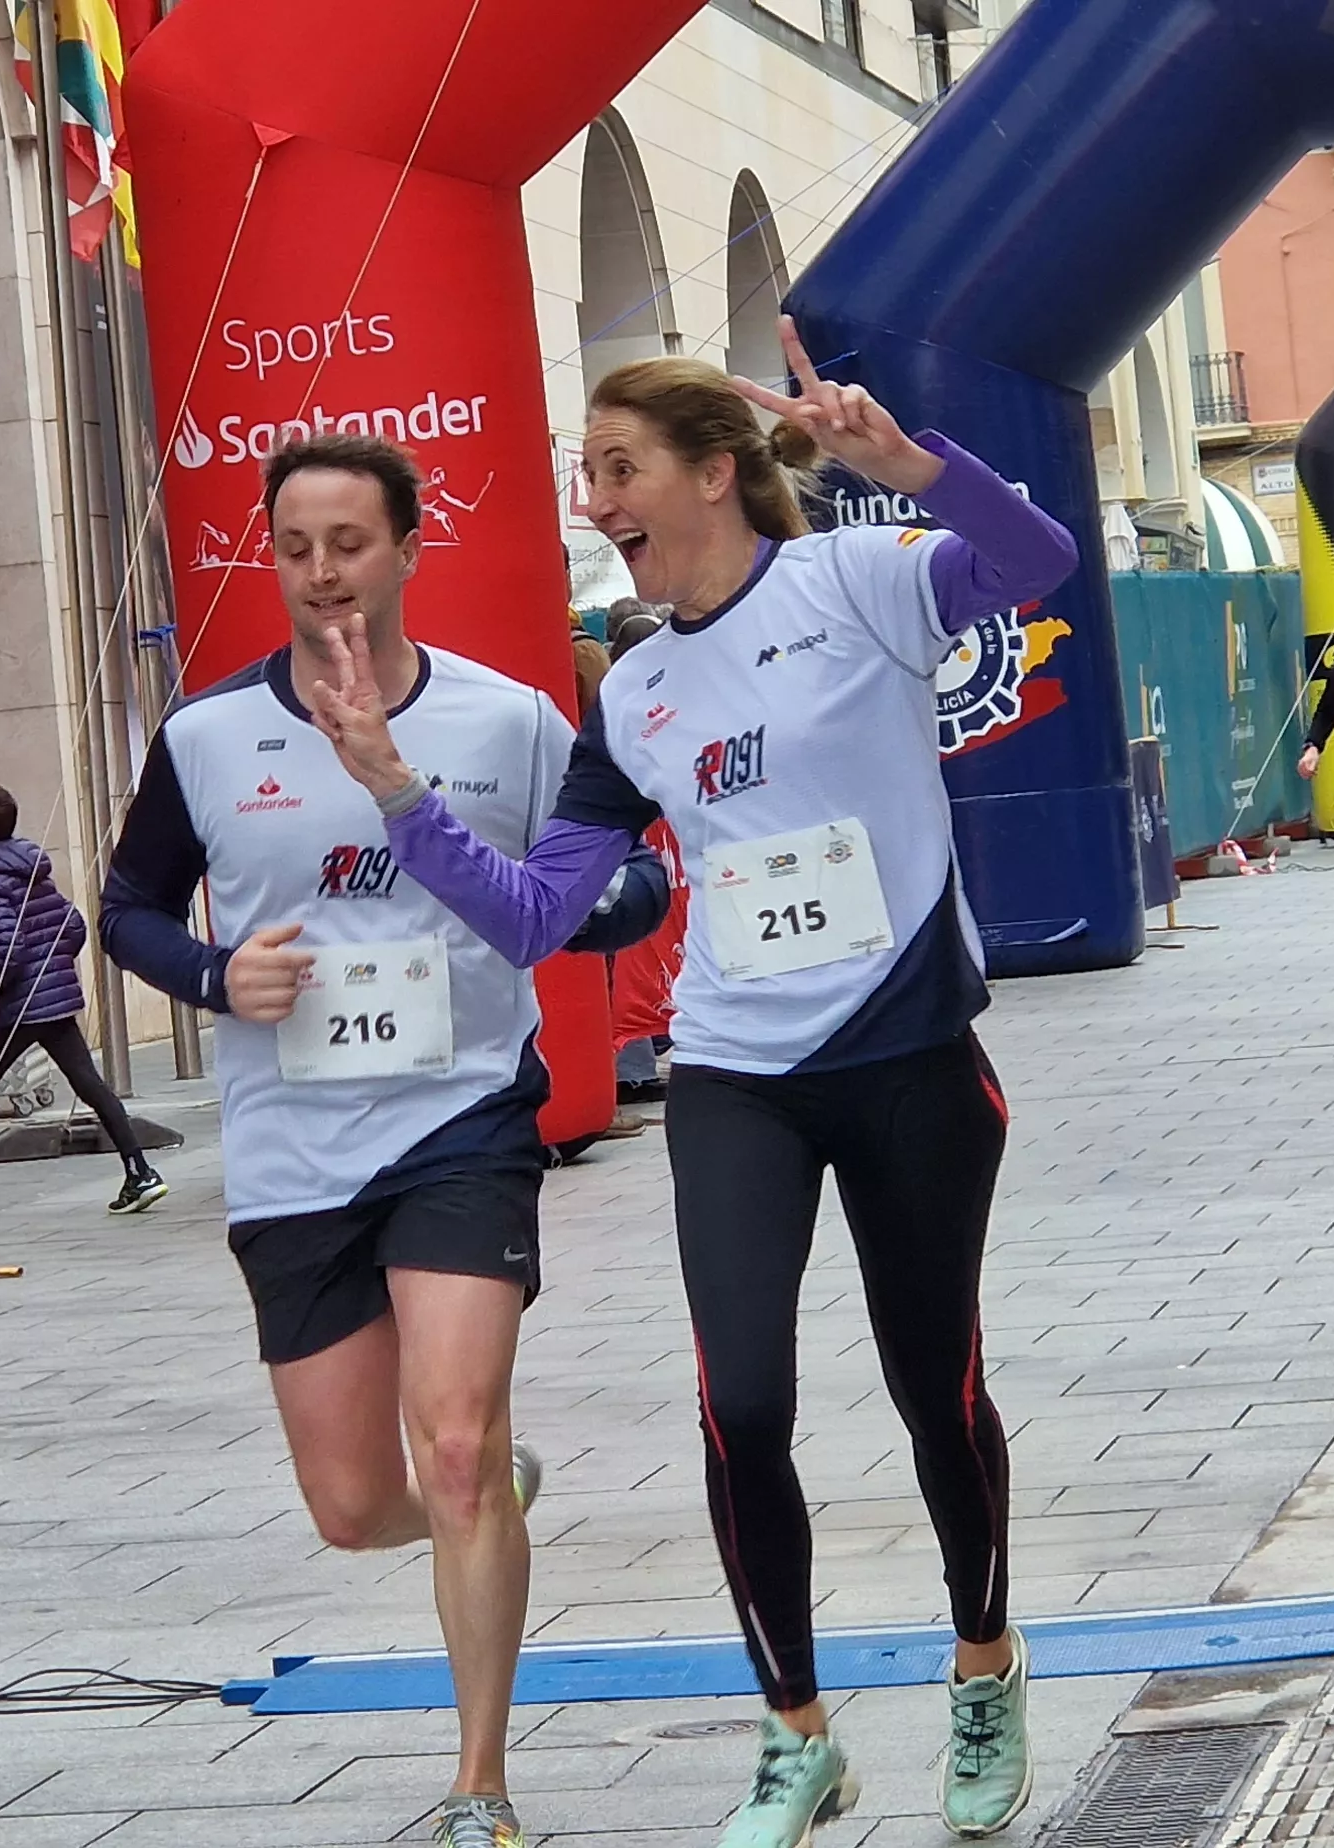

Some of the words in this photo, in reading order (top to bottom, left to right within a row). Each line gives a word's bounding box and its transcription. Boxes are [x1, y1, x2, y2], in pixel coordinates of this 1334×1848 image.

[222, 309, 395, 381] Sports
[218, 391, 487, 465] Santander
[1260, 480, 1294, 490] ALTO
[786, 627, 829, 656] mupol
[936, 689, 976, 711] LICÍA
[451, 777, 499, 798] mupol
[235, 794, 304, 815] Santander
[756, 899, 827, 941] 215
[327, 1010, 398, 1046] 216
